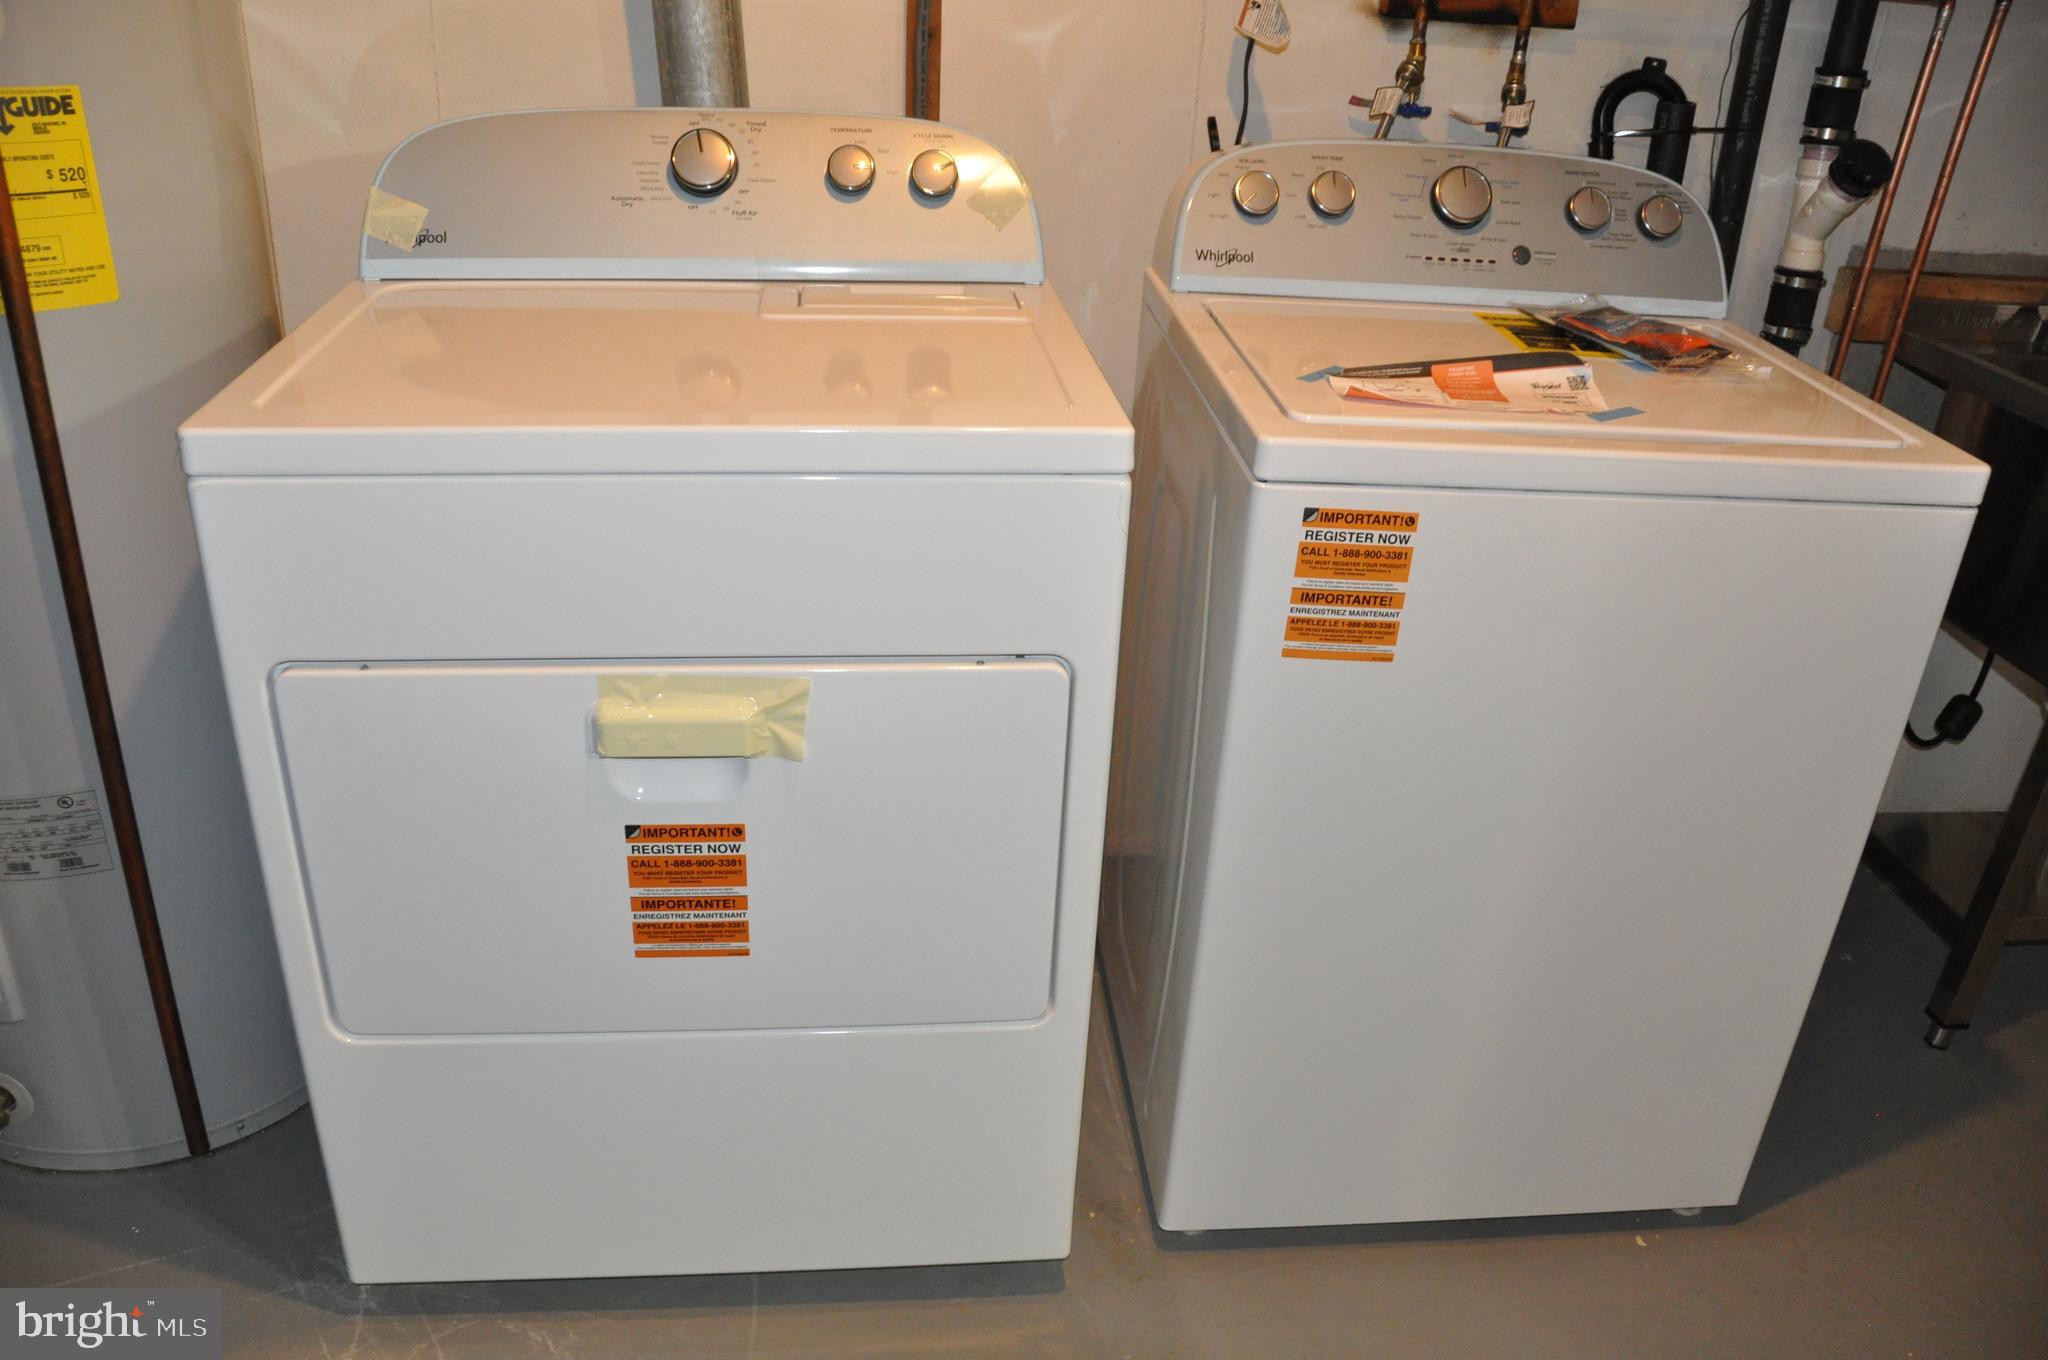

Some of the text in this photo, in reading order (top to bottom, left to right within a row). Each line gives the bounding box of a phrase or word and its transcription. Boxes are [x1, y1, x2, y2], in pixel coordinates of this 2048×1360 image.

[46, 166, 86, 182] $ 520
[1195, 248, 1254, 267] Whirlpool
[1319, 511, 1404, 526] IMPORTANT!
[1304, 530, 1411, 545] REGISTER NOW
[1301, 546, 1408, 560] CALL 1-888-900-3381
[1300, 592, 1392, 607] IMPORTANTE!
[1290, 607, 1400, 618] ENREGISTREZ MAINTENANT
[1290, 618, 1327, 626] APPELEZ
[1341, 621, 1396, 629] 1-888-900-3381
[643, 827, 730, 838] IMPORTANT!
[631, 844, 741, 854] REGISTER NOW
[631, 859, 742, 868] CALL 1-888-900-3381
[641, 899, 736, 909] IMPORTANTE!
